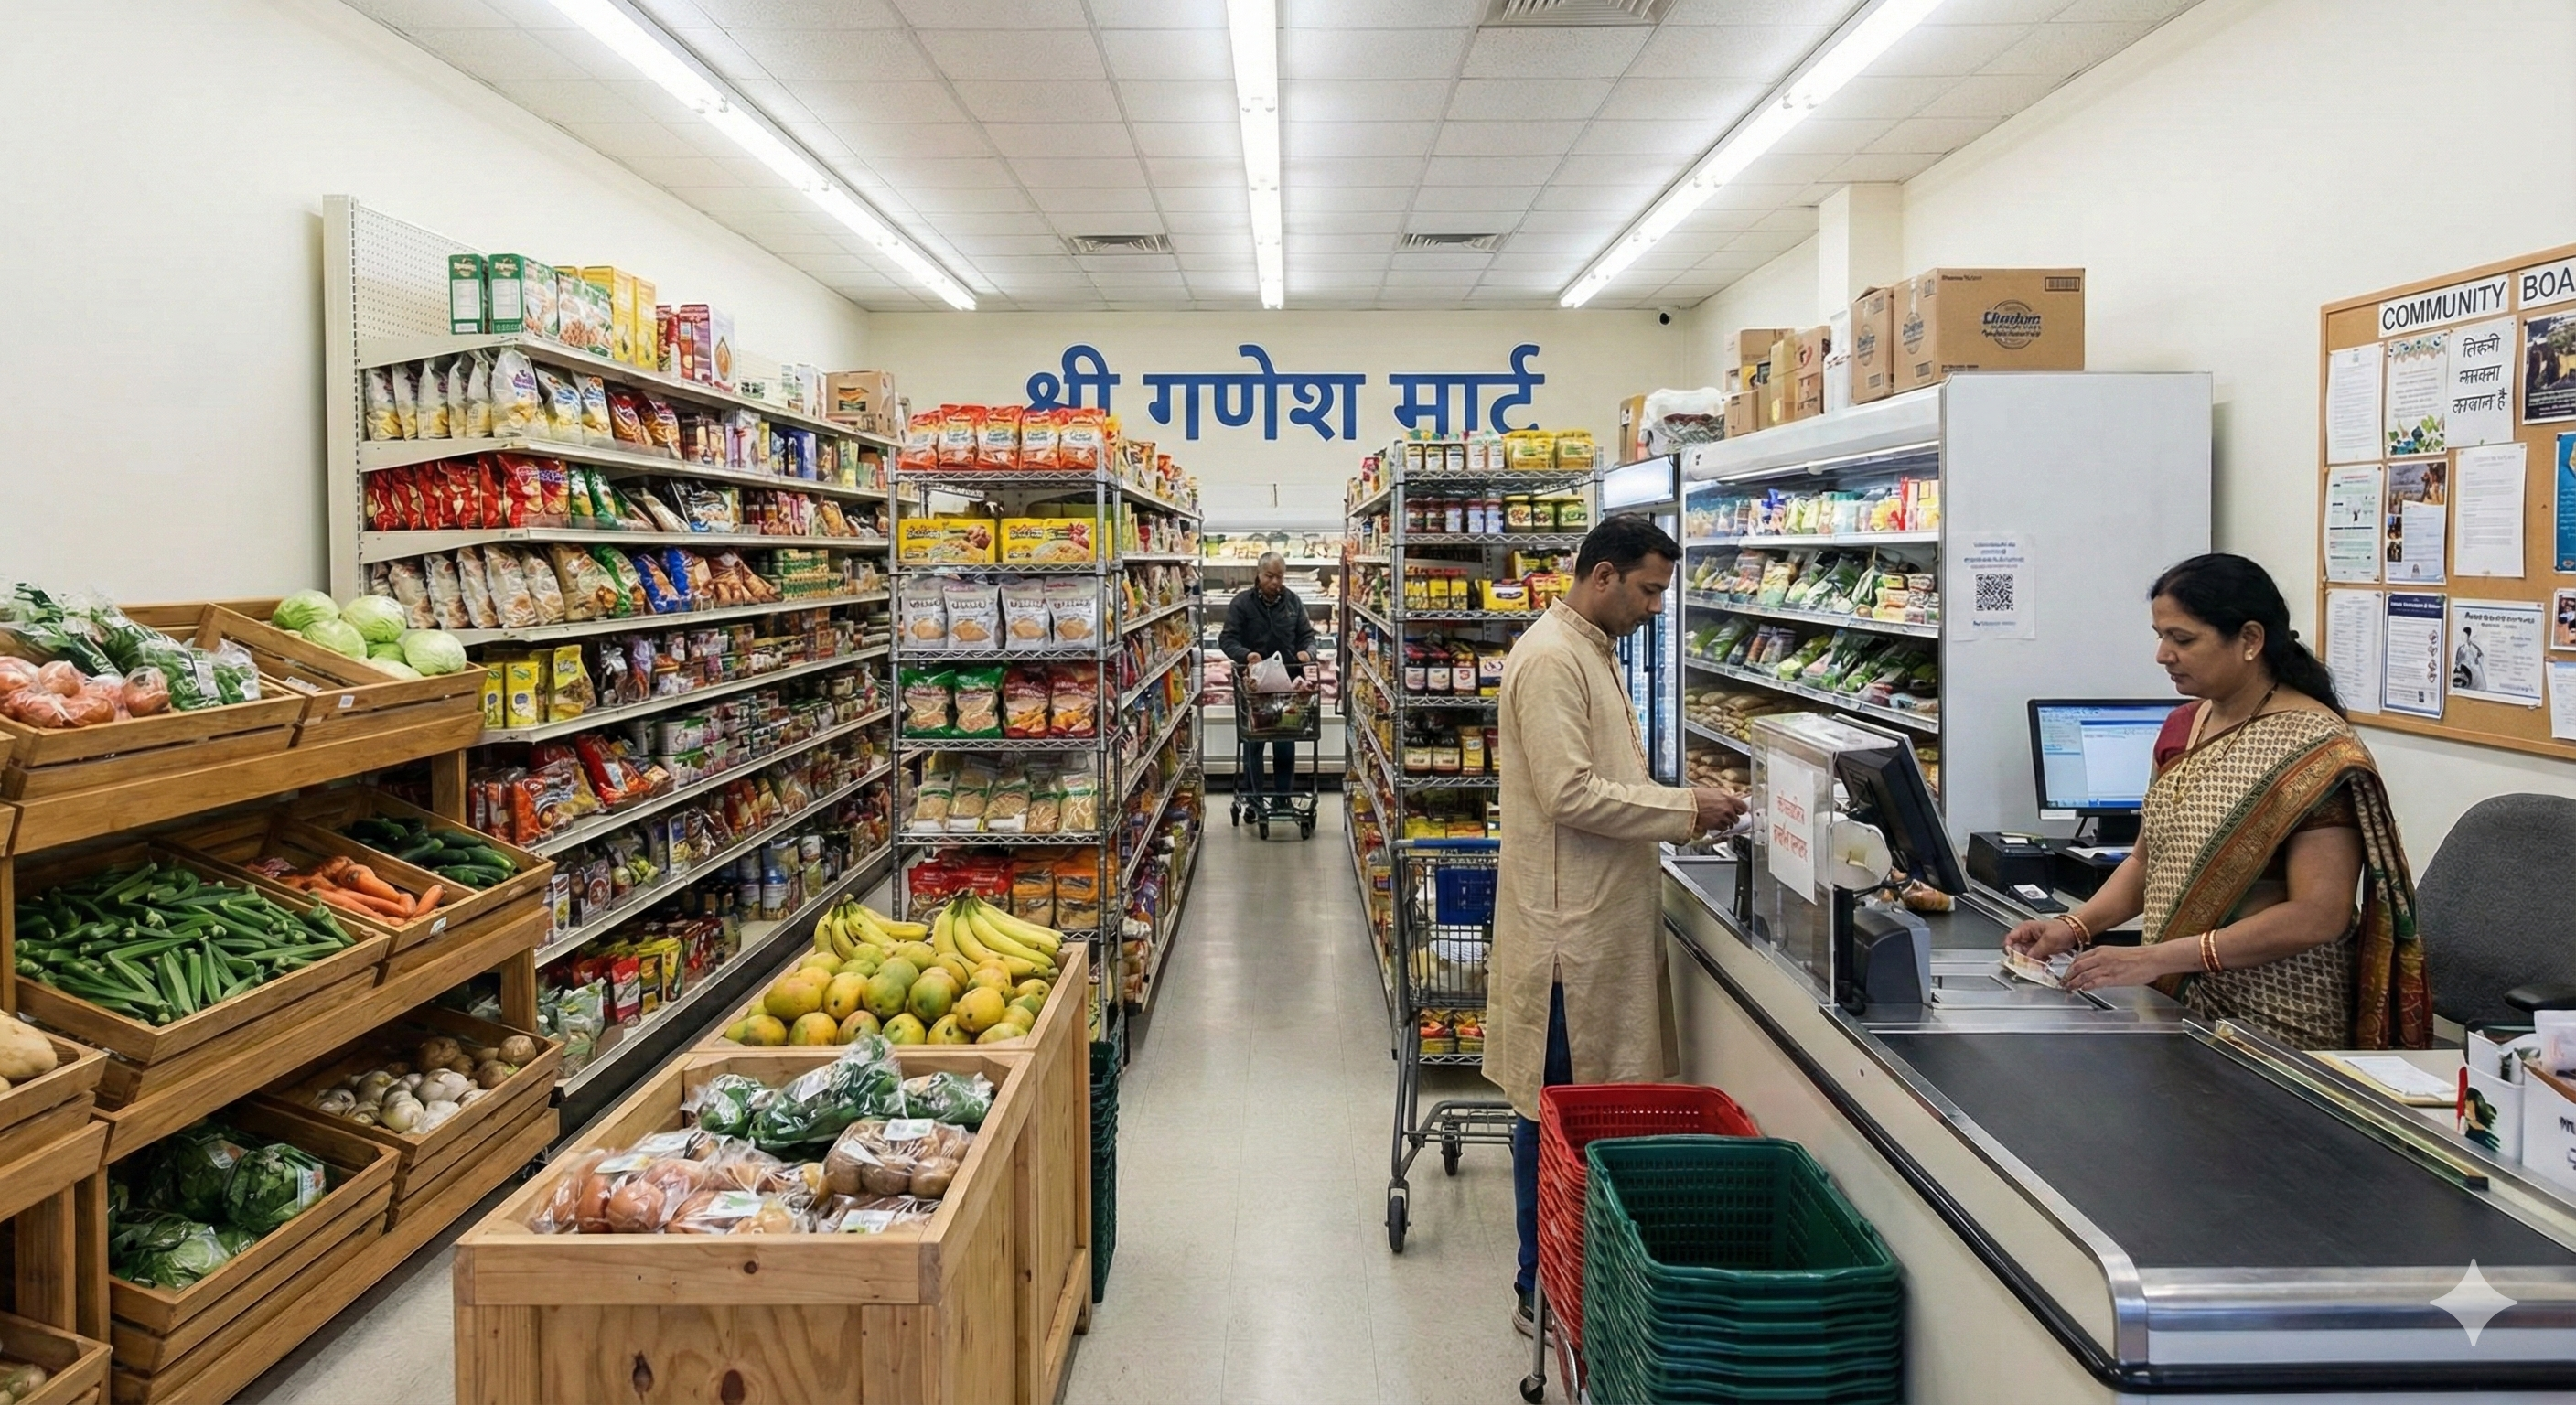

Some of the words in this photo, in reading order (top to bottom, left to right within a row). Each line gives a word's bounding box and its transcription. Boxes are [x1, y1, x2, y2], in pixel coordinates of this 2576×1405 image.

[2382, 281, 2506, 331] COMMUNITY
[2522, 266, 2576, 302] BOA
[1025, 344, 1120, 417] श्री
[1143, 343, 1366, 441] गणेश
[1389, 343, 1546, 434] मार्ट
